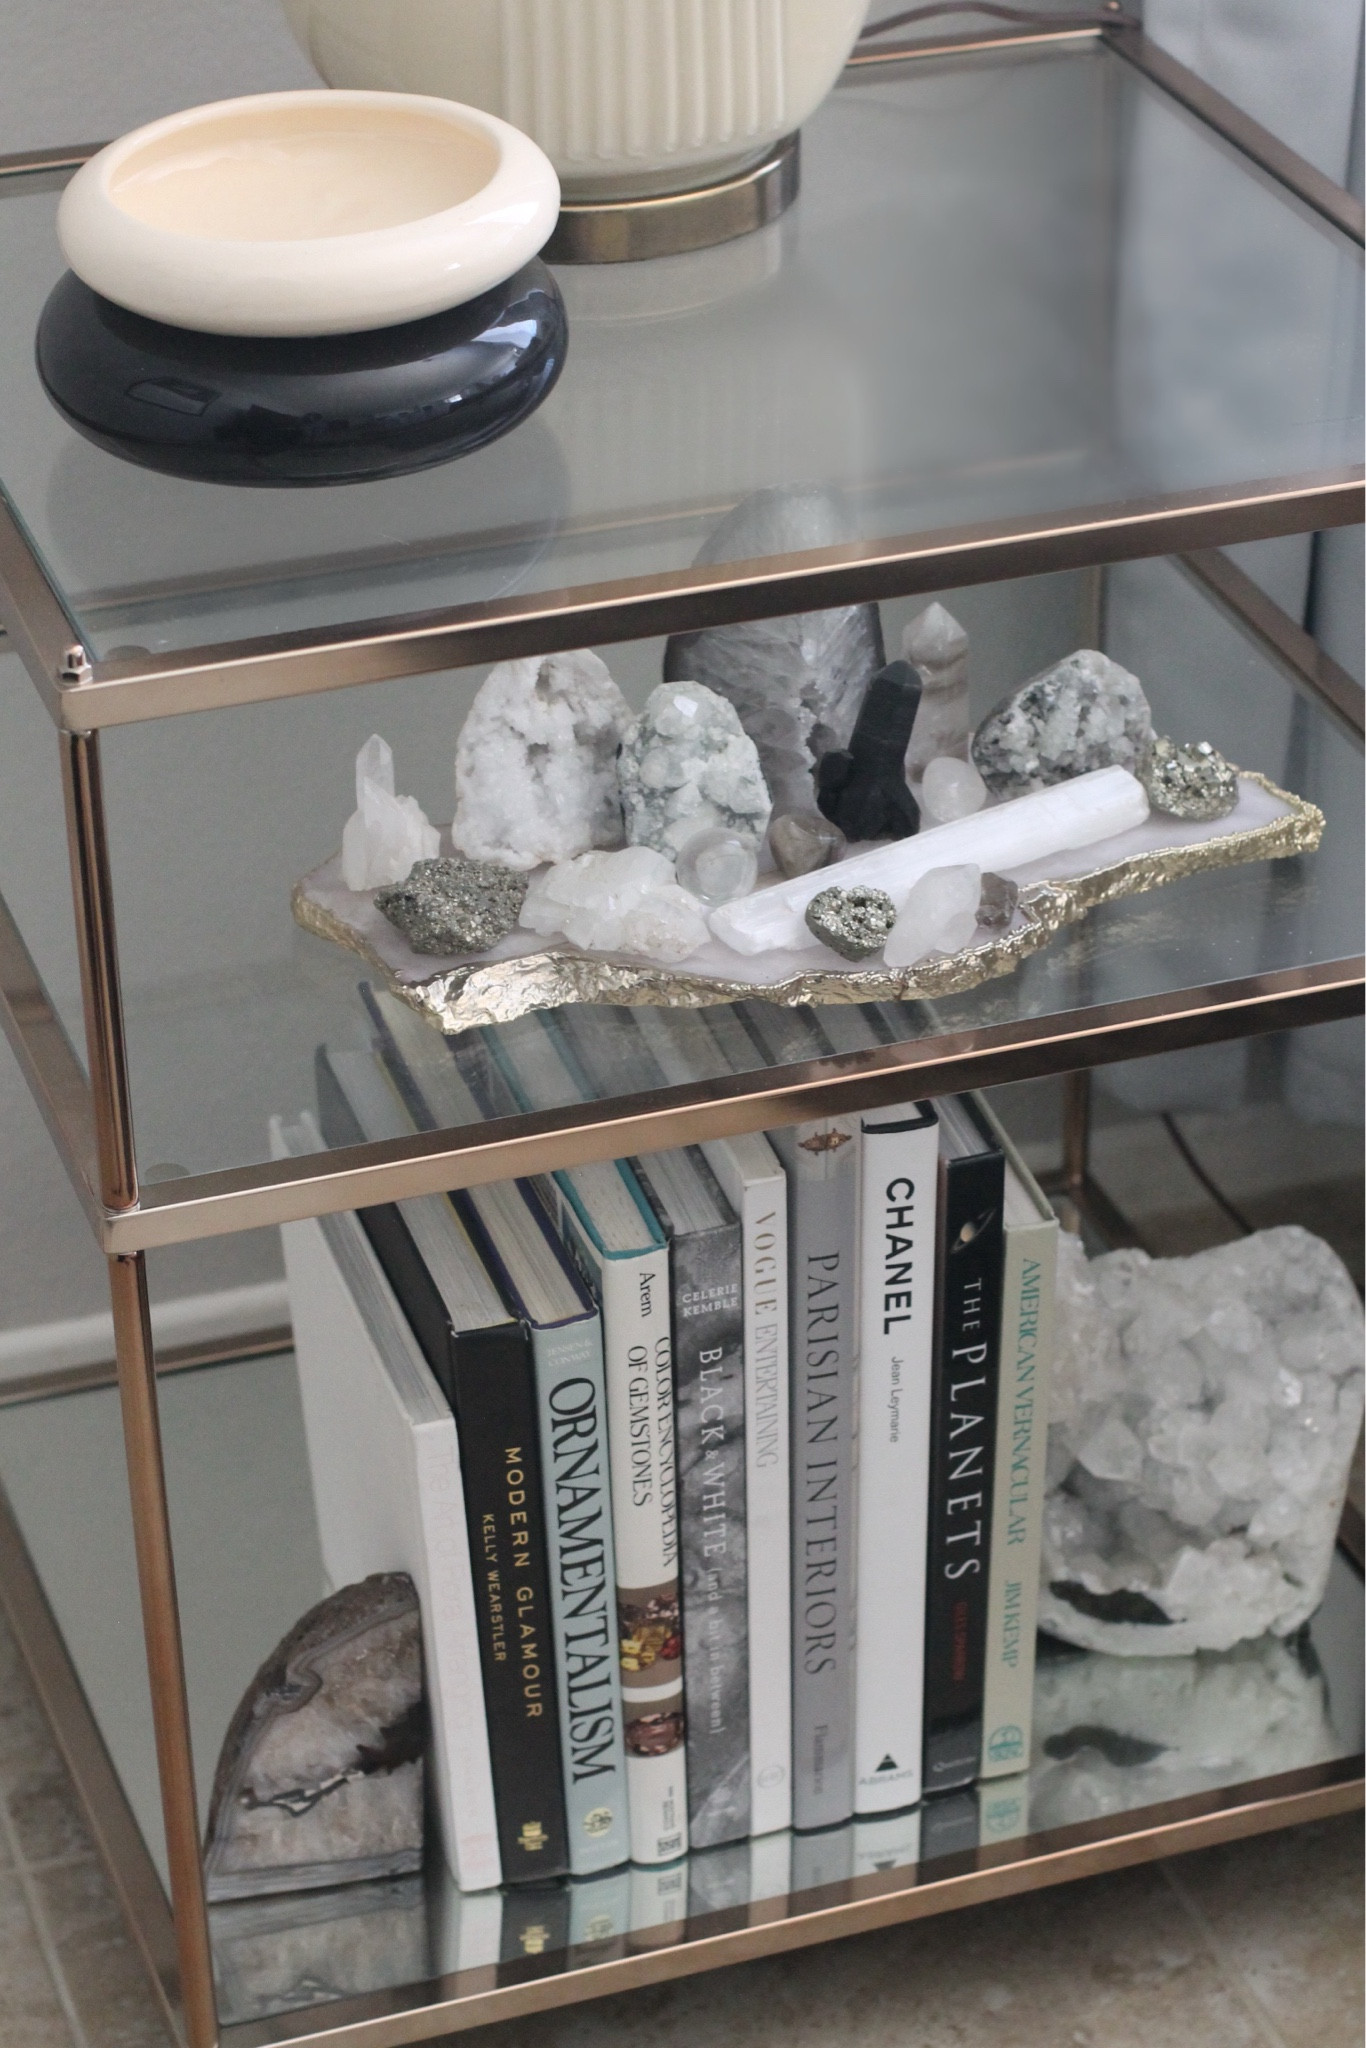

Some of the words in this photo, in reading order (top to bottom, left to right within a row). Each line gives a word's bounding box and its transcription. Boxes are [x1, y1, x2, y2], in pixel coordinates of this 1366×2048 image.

[639, 1271, 656, 1318] Arem
[682, 1283, 738, 1304] CELERIE
[754, 1211, 777, 1316] VOGUE
[884, 1177, 916, 1336] CHANEL
[962, 1276, 983, 1332] THE
[683, 1296, 738, 1318] KEMBLE
[806, 1252, 840, 1444] PARISIAN
[1016, 1258, 1042, 1383] AMERICAN
[627, 1345, 648, 1374] OF
[699, 1346, 725, 1445] BLACK
[754, 1322, 780, 1469] ENTERTAINING
[891, 1355, 904, 1386] Jean
[628, 1376, 653, 1507] GEMSTONES
[705, 1450, 720, 1461] &
[889, 1387, 904, 1443] Leymarie
[944, 1341, 988, 1580] PLANETS
[504, 1446, 531, 1567] MODERN
[702, 1462, 727, 1558] WHITE
[1007, 1385, 1035, 1546] VERNACULAR
[482, 1513, 498, 1563] KELLY
[548, 1376, 617, 1786] ORNAMENTALISM
[804, 1459, 838, 1676] INTERIORS
[487, 1569, 506, 1662] WEARSTLER
[1002, 1612, 1022, 1668] KEMP
[1004, 1580, 1022, 1611] JIM
[515, 1586, 543, 1719] GLAMOUR
